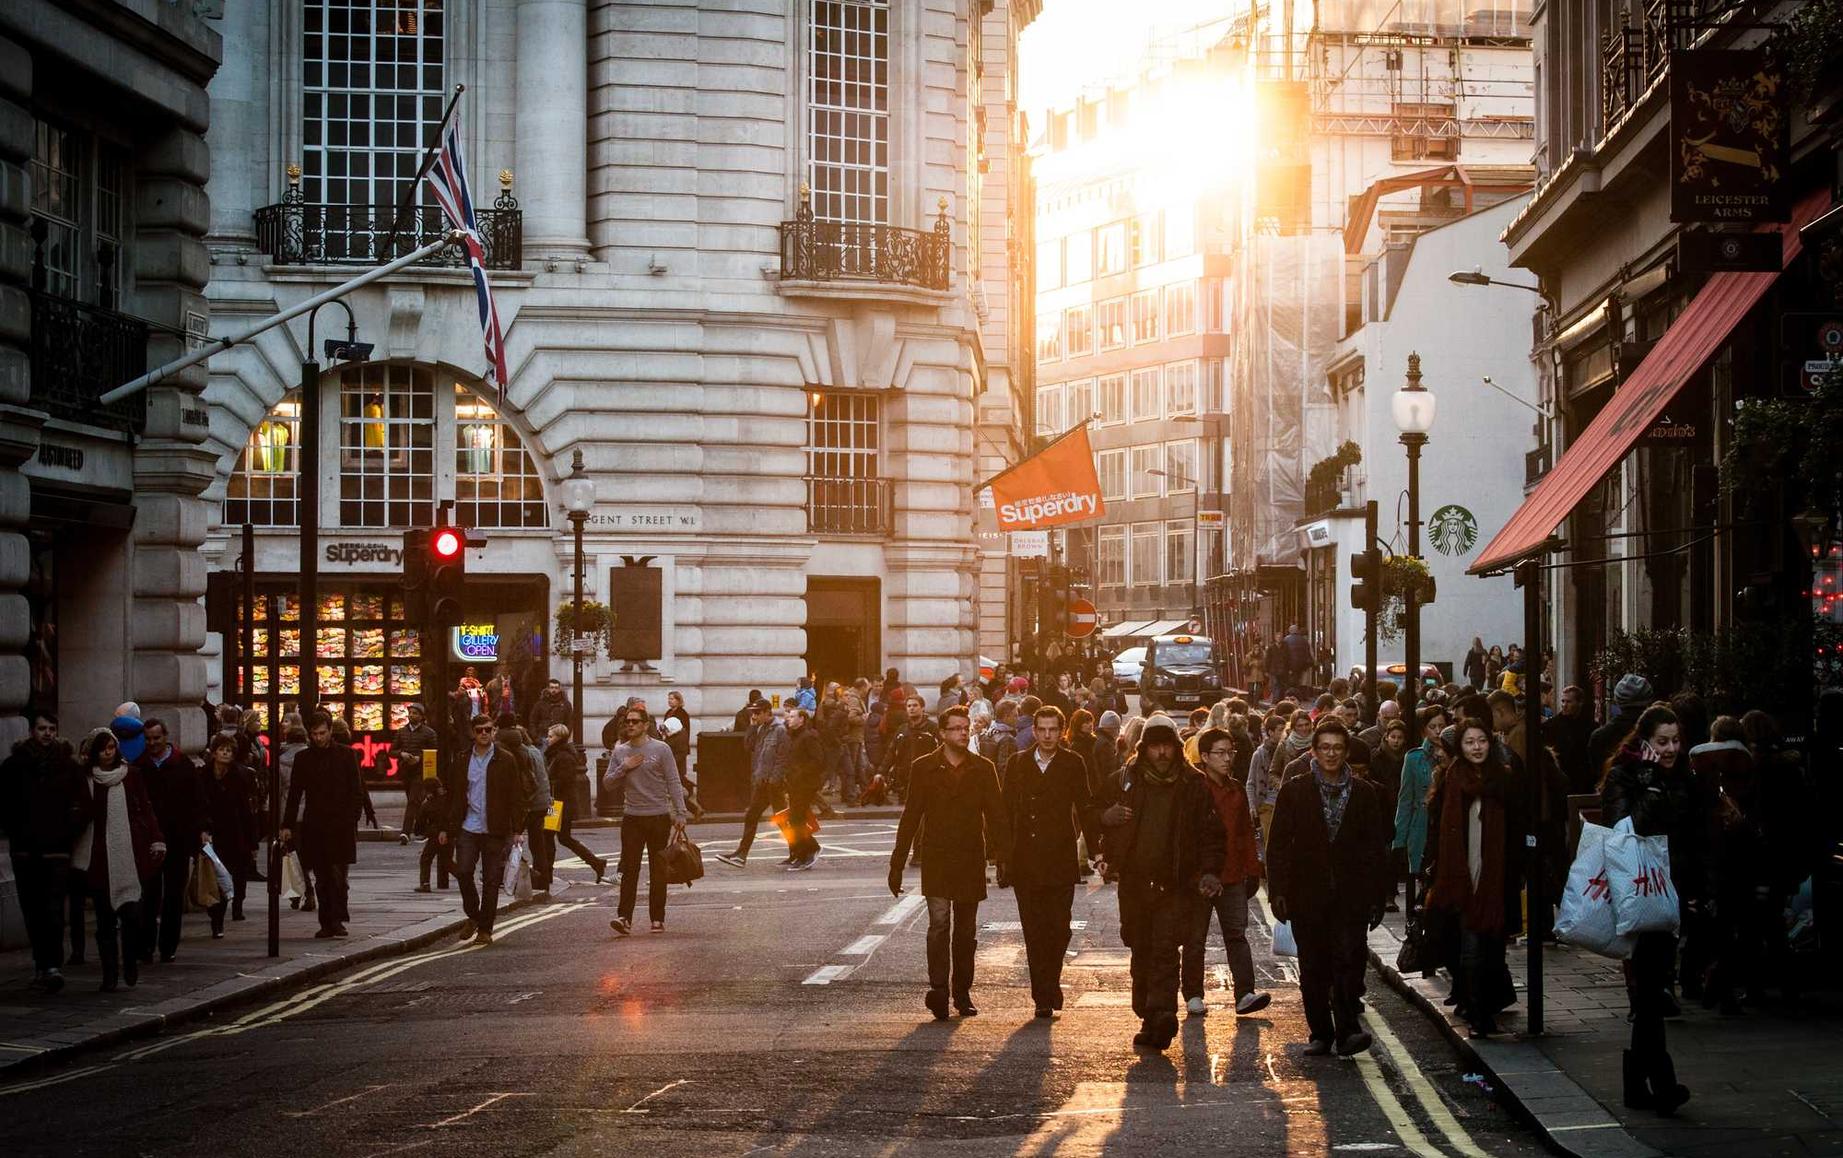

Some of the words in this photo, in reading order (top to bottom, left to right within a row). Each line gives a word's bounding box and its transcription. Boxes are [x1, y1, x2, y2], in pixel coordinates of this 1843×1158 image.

[1695, 194, 1769, 205] LEICESTER
[1712, 207, 1752, 217] ARMS
[1000, 492, 1097, 524] Superdry
[632, 515, 673, 525] STREET
[326, 544, 404, 566] Superdry
[460, 624, 495, 636] T-SHIRT
[462, 634, 499, 646] GALLERY
